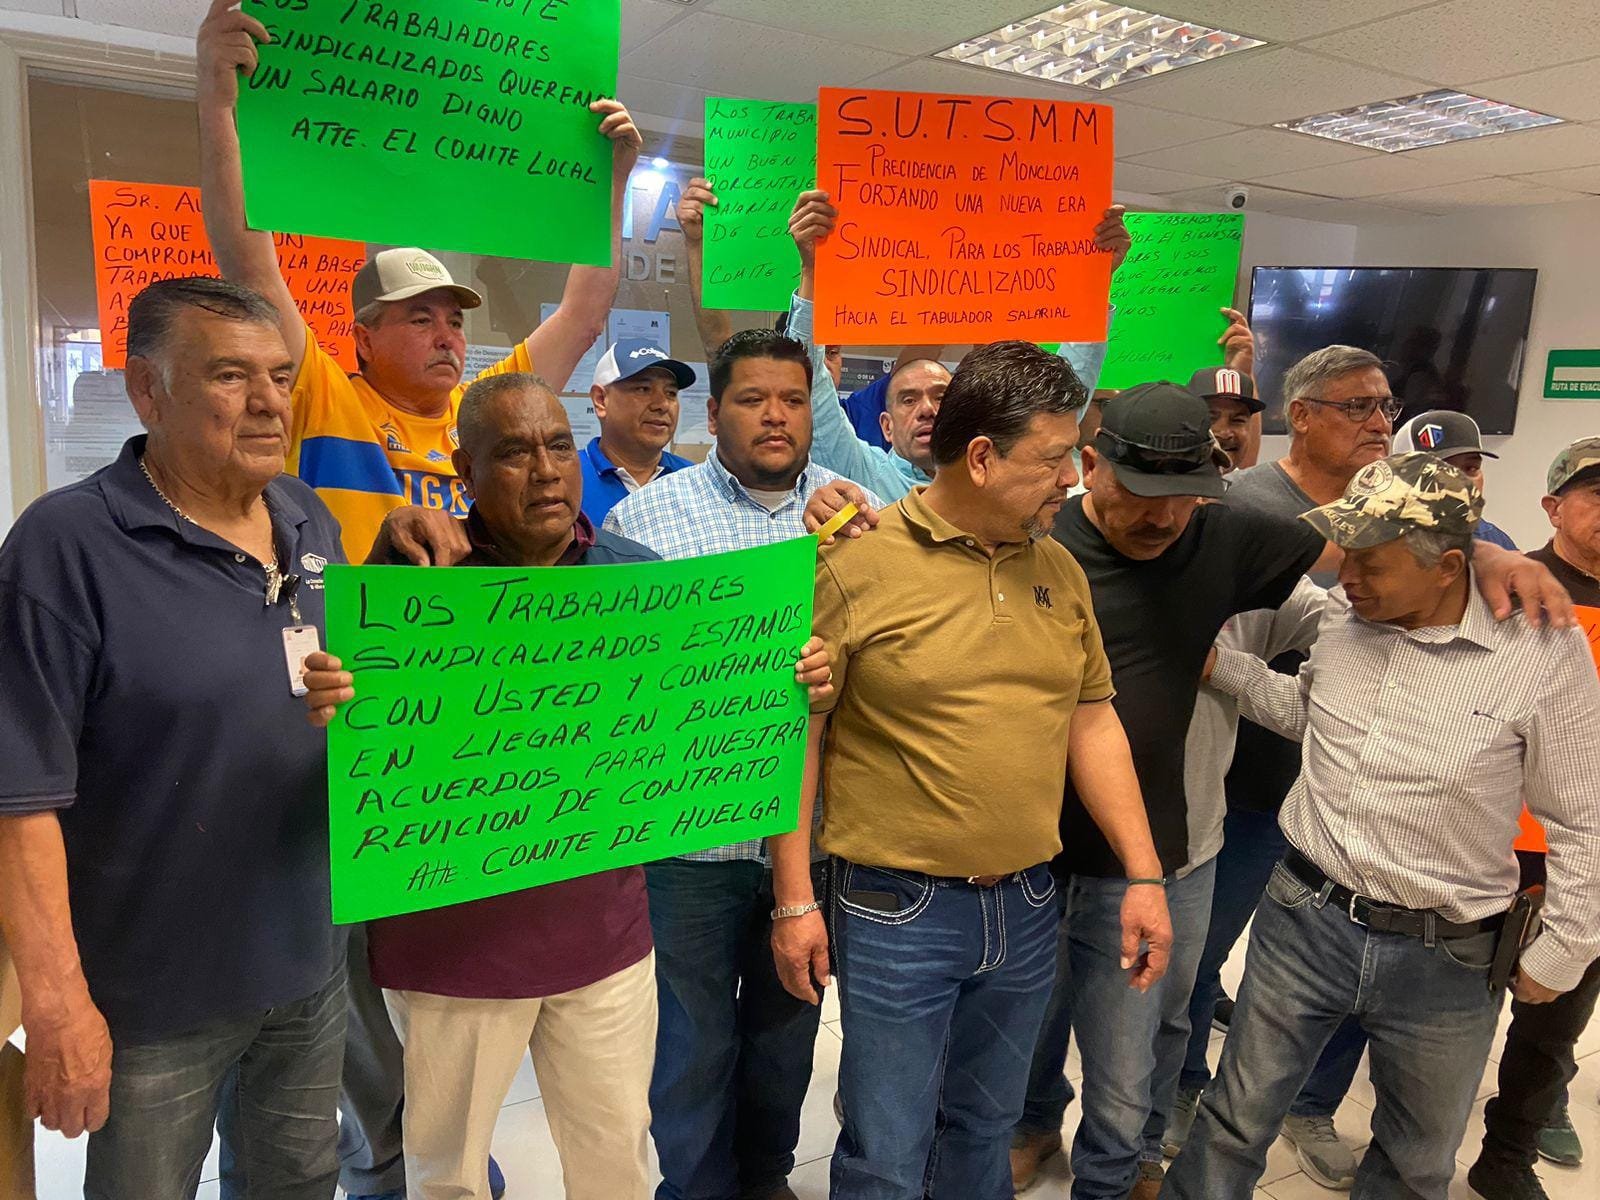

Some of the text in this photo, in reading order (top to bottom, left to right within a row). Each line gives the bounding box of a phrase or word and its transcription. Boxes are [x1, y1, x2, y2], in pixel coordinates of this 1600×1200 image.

[256, 24, 484, 83] SINDICALIZADOS
[250, 63, 522, 132] UN SALARIO DIGNO
[710, 101, 749, 120] LOS
[292, 117, 596, 184] ATTE. EL COMITE LOCAL
[710, 127, 797, 144] MUNICIPIO
[709, 156, 734, 170] UN
[747, 154, 797, 171] BUEN
[867, 144, 1079, 182] PRECIDENCIA DE MONCLOVA
[107, 187, 159, 209] SR.
[707, 174, 816, 191] PORCENTAJE
[834, 164, 1086, 214] FORJANDO UNA NUEVA ERA
[104, 214, 133, 240] YA
[151, 222, 192, 241] QUE
[941, 226, 985, 259] PARA
[993, 244, 1020, 259] LOS
[288, 254, 308, 270] LA
[315, 254, 365, 273] BASE
[626, 249, 676, 284] DE
[710, 263, 776, 284] COMITE
[306, 277, 348, 294] UNA
[876, 268, 1057, 297] SINDICALIZADOS
[835, 305, 1071, 327] HACIA EL TABULADOR SALARIAL
[1569, 382, 1578, 391] DE
[359, 575, 745, 629] LOS TRABAJADORES
[351, 633, 660, 672] SINDICALIZADOS
[681, 603, 803, 651] ESTAMOS
[345, 645, 799, 731] CON USTED Y CONFIAMOS
[349, 744, 415, 779] EN
[610, 707, 658, 738] EN
[676, 689, 790, 731] BUENOS
[355, 715, 806, 815] ACUERDOS PARA NUESTRA
[352, 755, 780, 859] REVICION DE CONTRATO
[481, 833, 599, 877] COMITE
[608, 824, 653, 851] DE
[670, 794, 780, 837] HUELGA
